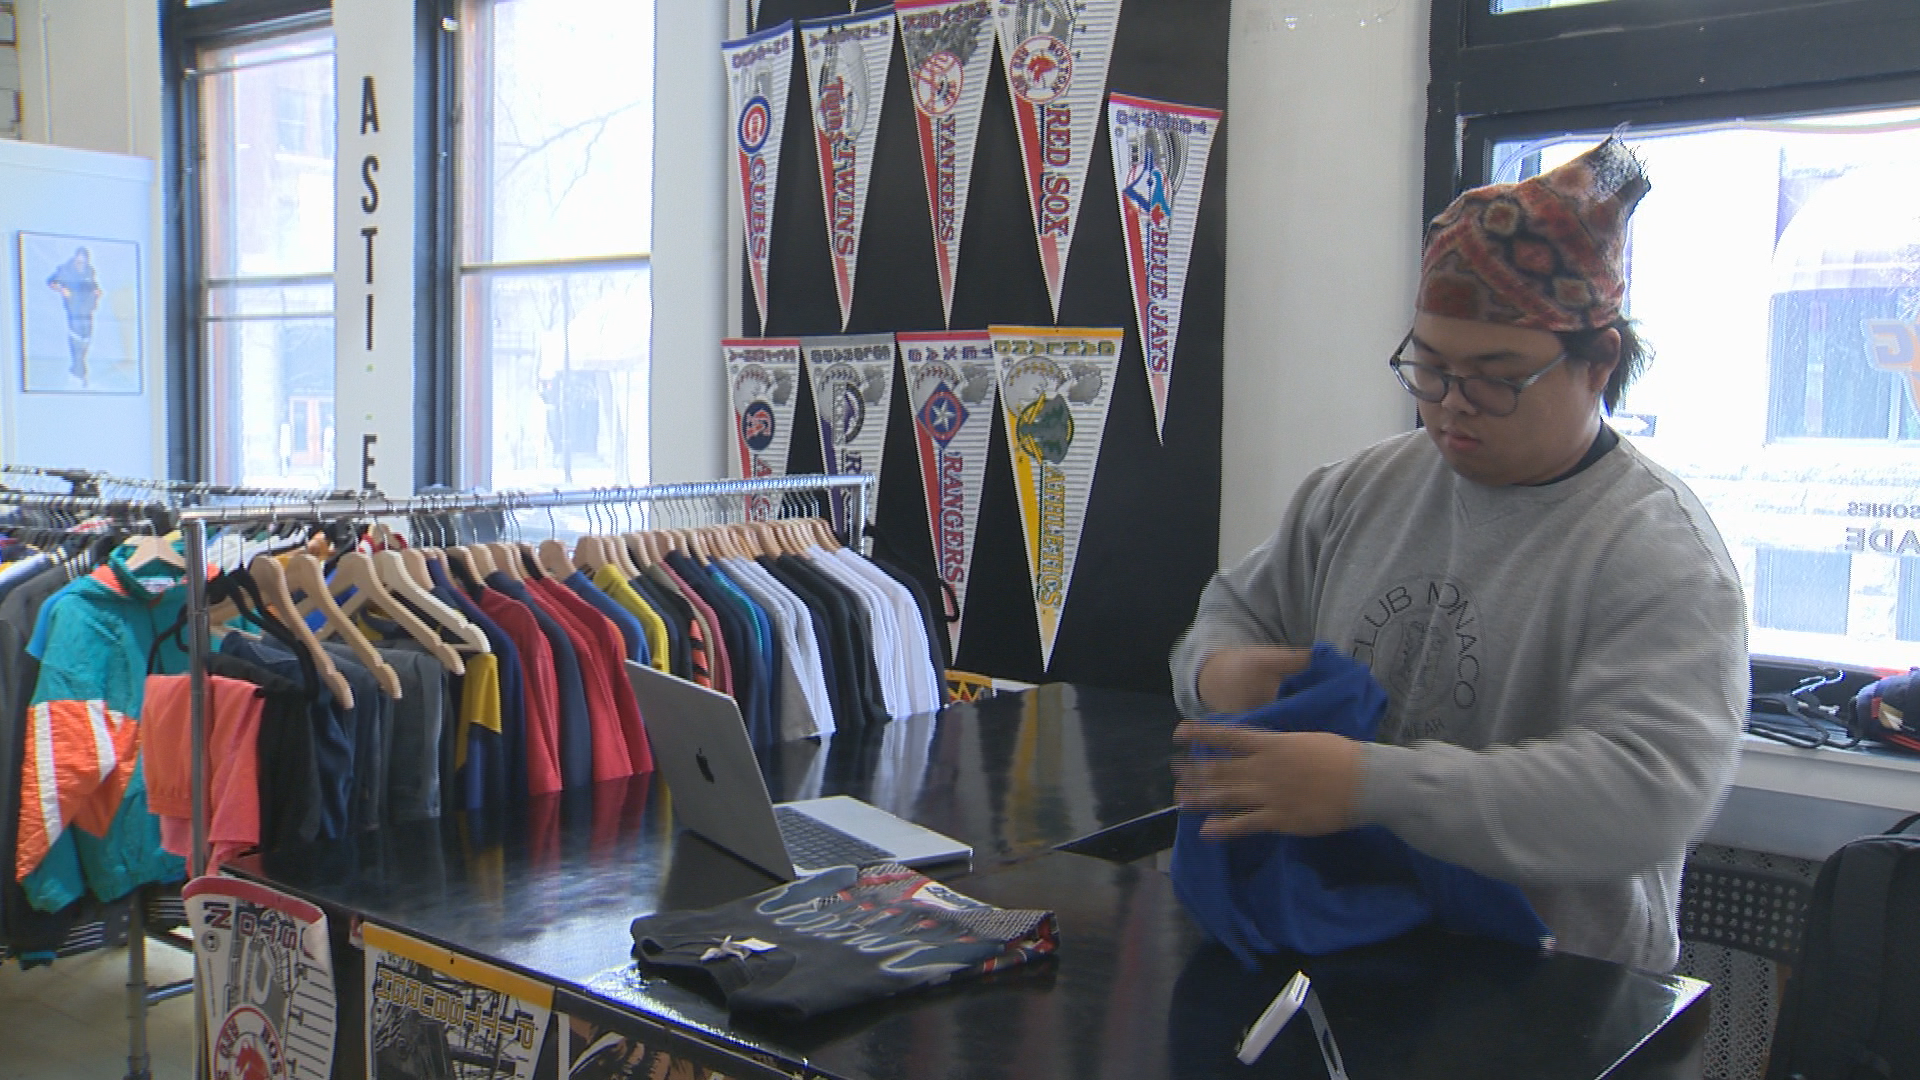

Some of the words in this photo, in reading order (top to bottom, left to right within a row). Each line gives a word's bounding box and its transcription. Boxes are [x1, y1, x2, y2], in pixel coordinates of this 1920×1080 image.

[940, 117, 955, 241] YANKEES
[1046, 107, 1070, 166] RED
[750, 157, 767, 261] CUBS
[836, 143, 857, 257] TWINS
[1043, 177, 1070, 236] SOX
[1150, 230, 1168, 300] BLUE
[1150, 305, 1168, 373] JAYS
[943, 454, 965, 583] RANGERS
[1040, 467, 1066, 608] ATHLETICS
[375, 966, 536, 1050] PITTSBURGH
